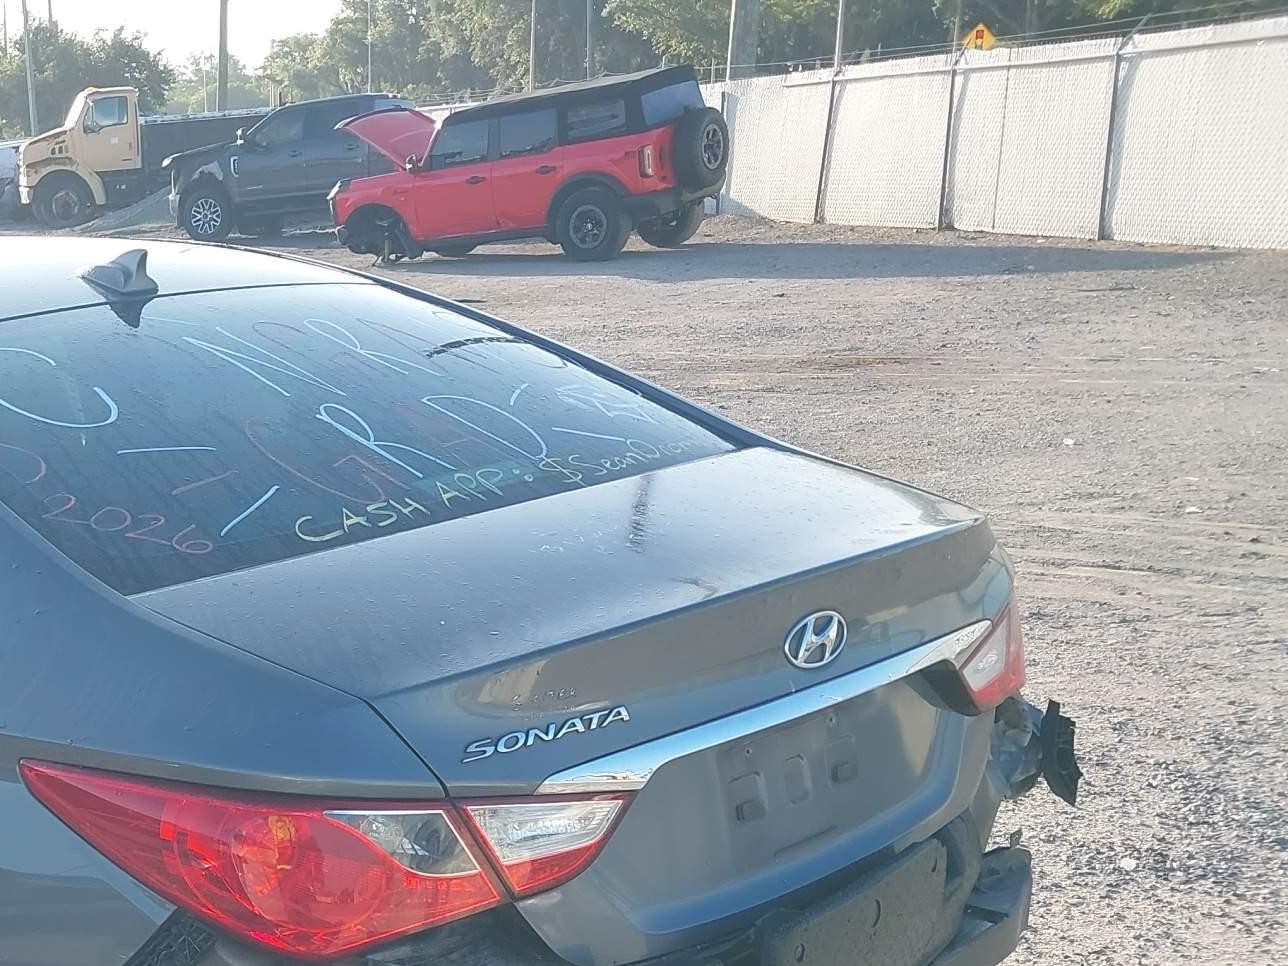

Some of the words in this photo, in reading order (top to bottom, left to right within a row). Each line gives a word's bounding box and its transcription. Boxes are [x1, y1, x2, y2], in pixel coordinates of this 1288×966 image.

[42, 493, 214, 555] 2026
[295, 496, 431, 542] CASH
[462, 704, 630, 764] SONATA
